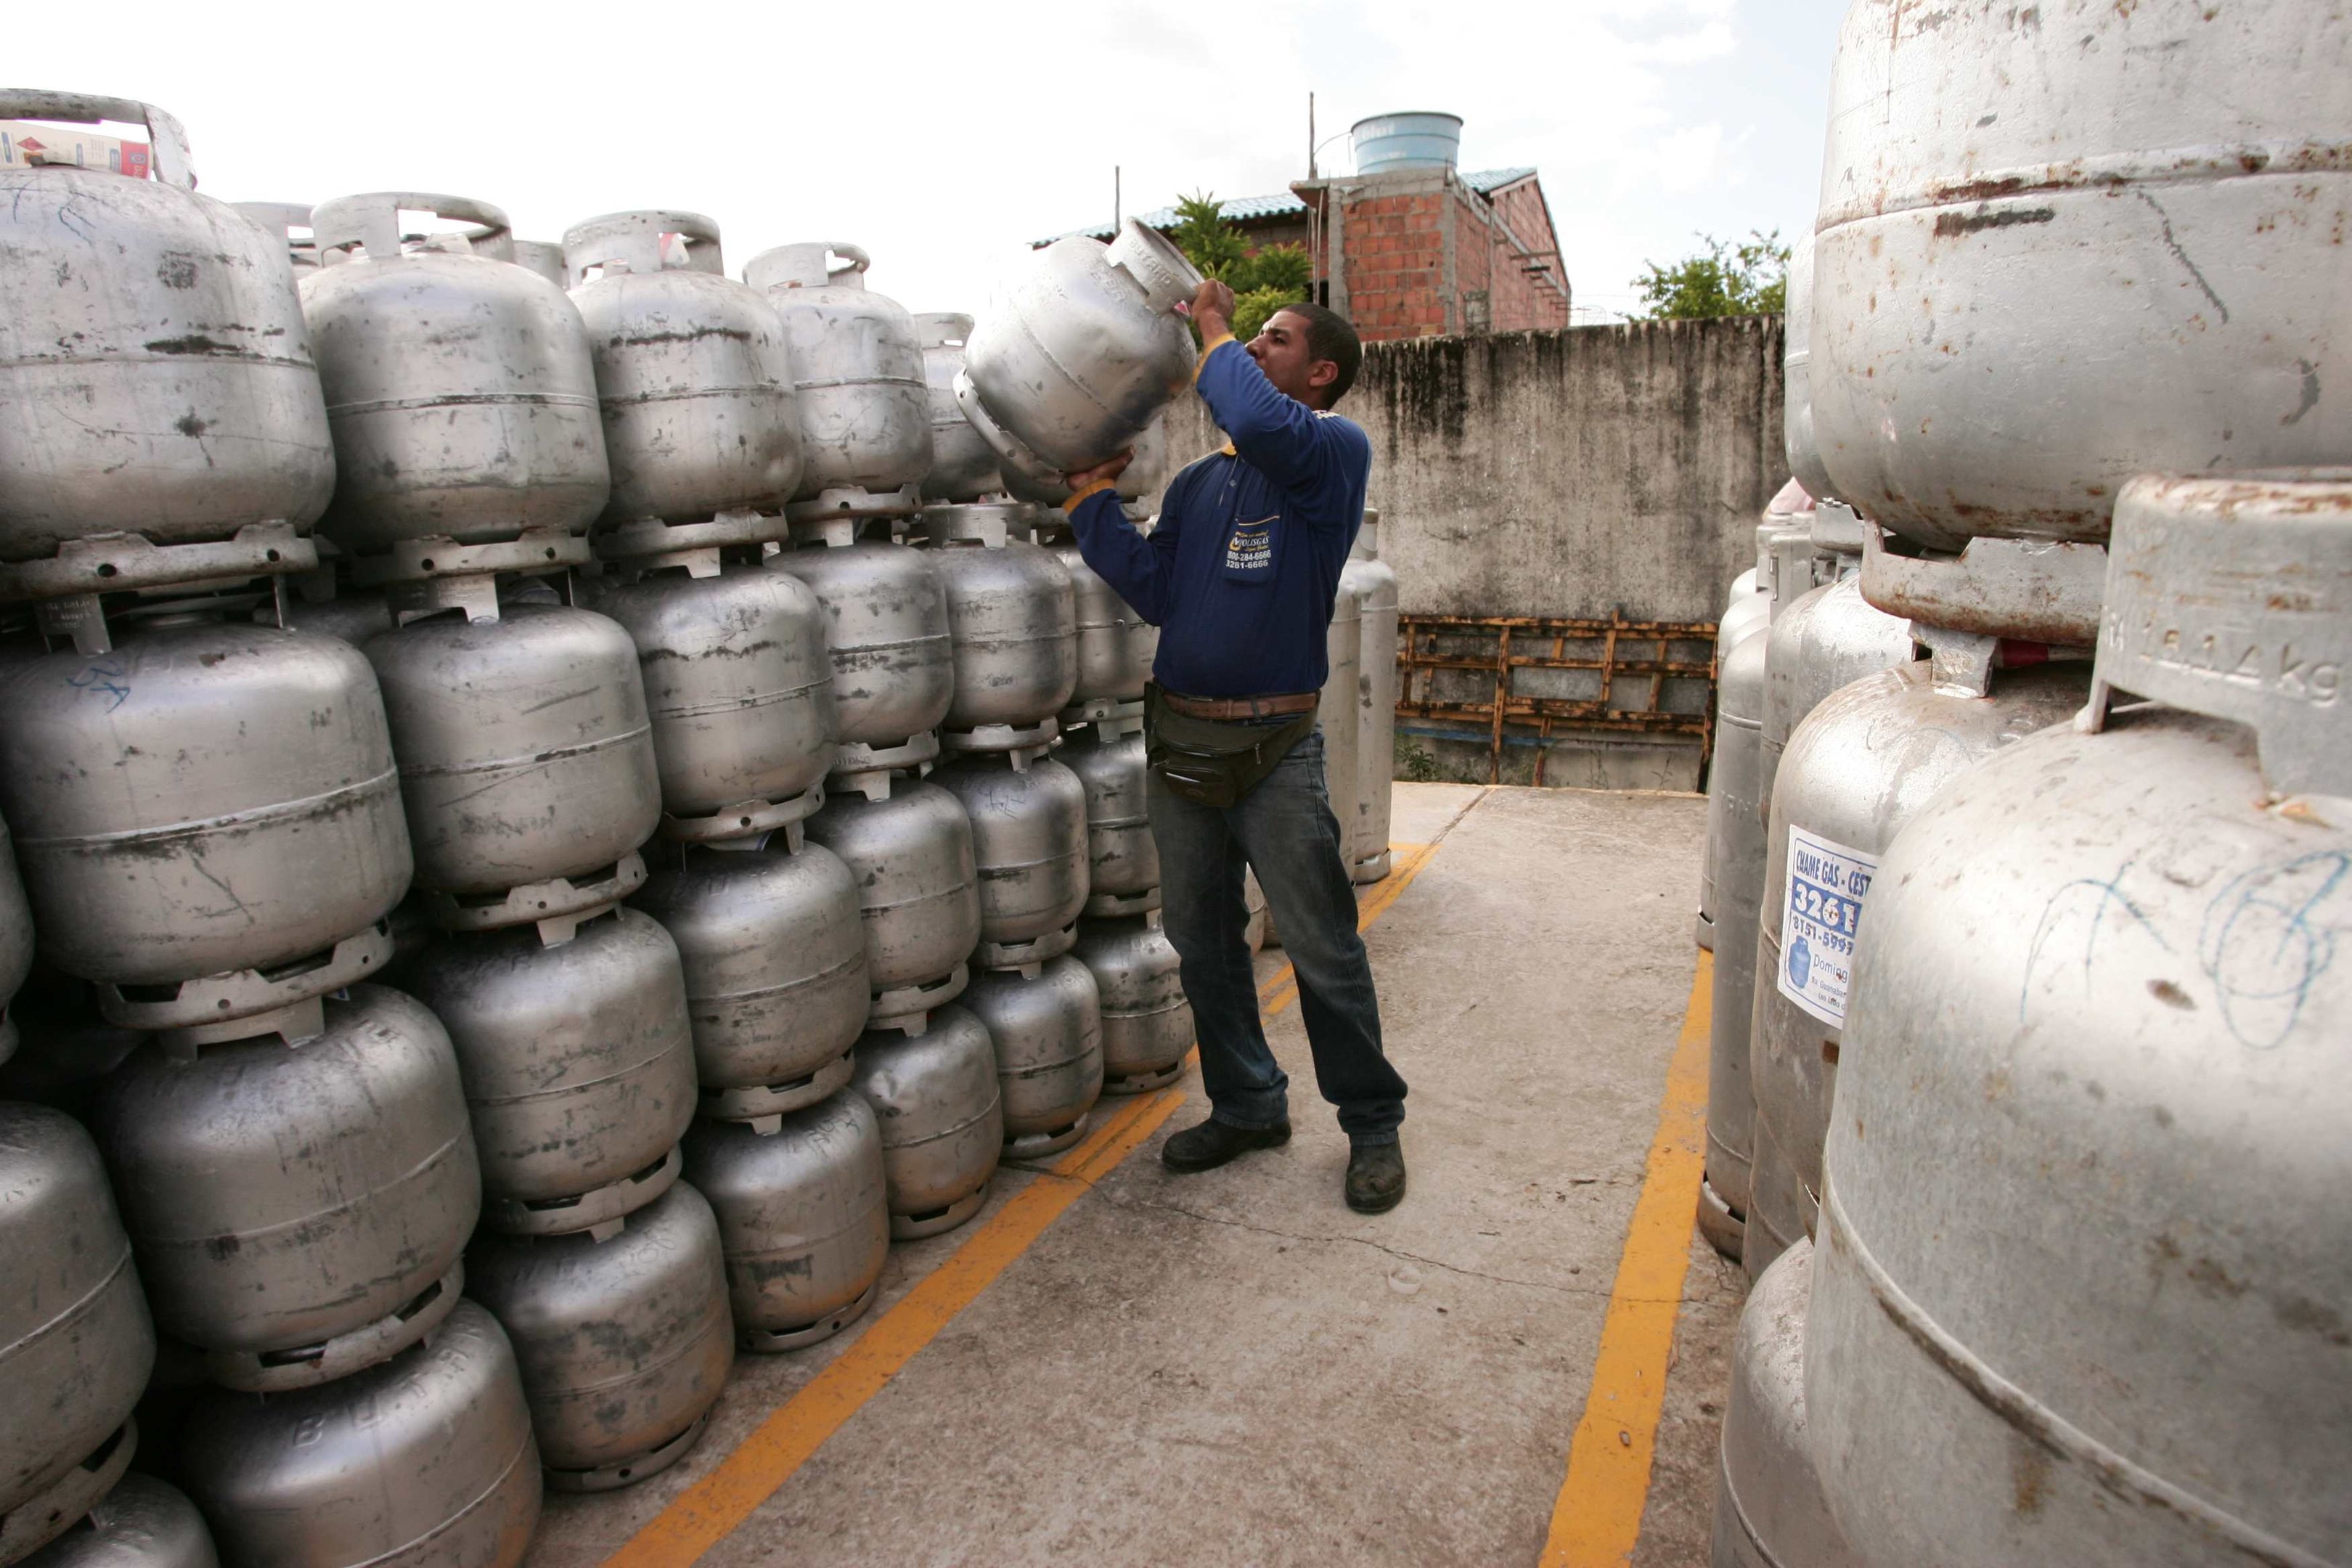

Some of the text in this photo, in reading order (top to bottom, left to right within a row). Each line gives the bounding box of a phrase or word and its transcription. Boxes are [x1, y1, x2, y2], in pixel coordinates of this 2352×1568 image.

[1225, 559, 1268, 569] 3281-6666
[1796, 849, 1821, 881] CHAME
[1813, 953, 1848, 984] Doming
